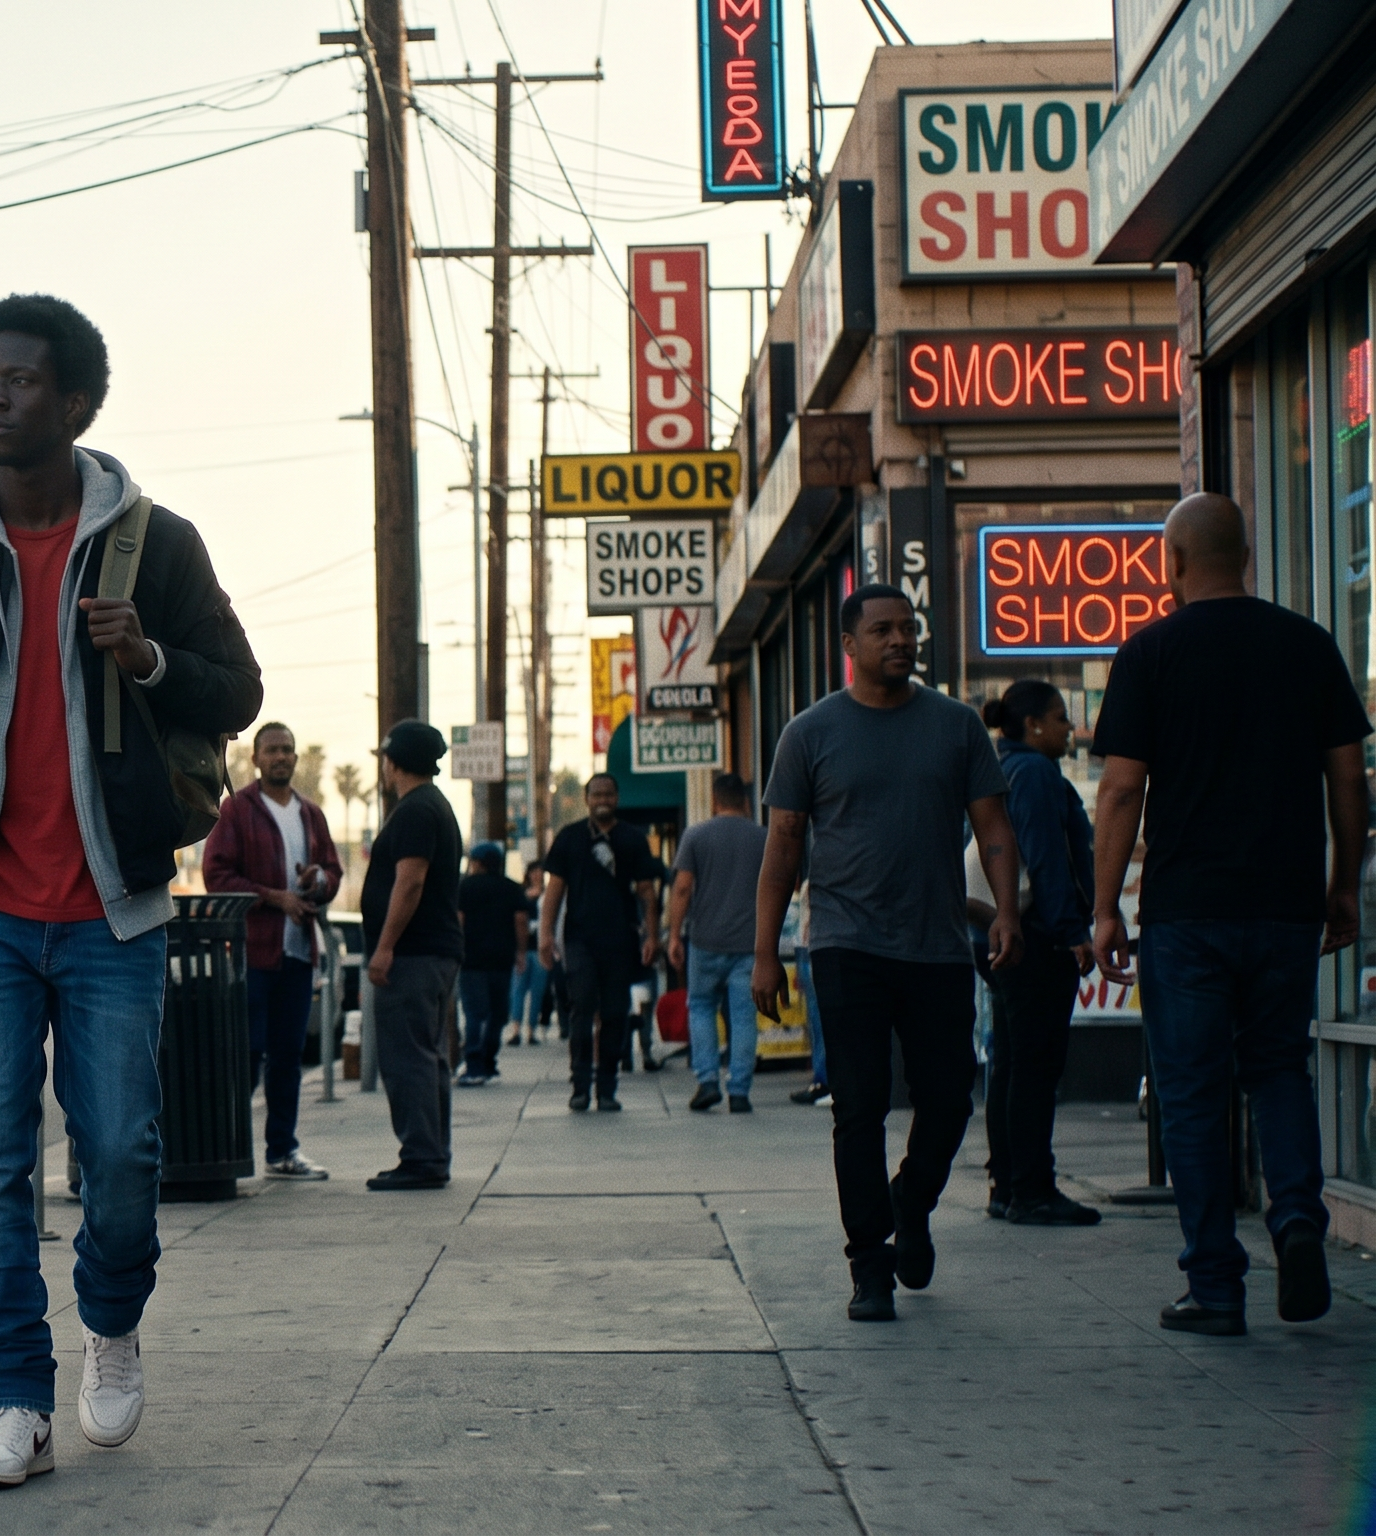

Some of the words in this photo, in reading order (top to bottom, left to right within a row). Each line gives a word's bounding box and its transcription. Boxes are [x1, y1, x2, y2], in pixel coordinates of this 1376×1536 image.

[1117, 33, 1191, 204] SMOKE
[909, 342, 1088, 409] SMOKE
[1104, 339, 1183, 404] SH
[552, 462, 734, 503] LIQUOR
[596, 529, 705, 560] SMOKE
[599, 566, 704, 597] SHOPS
